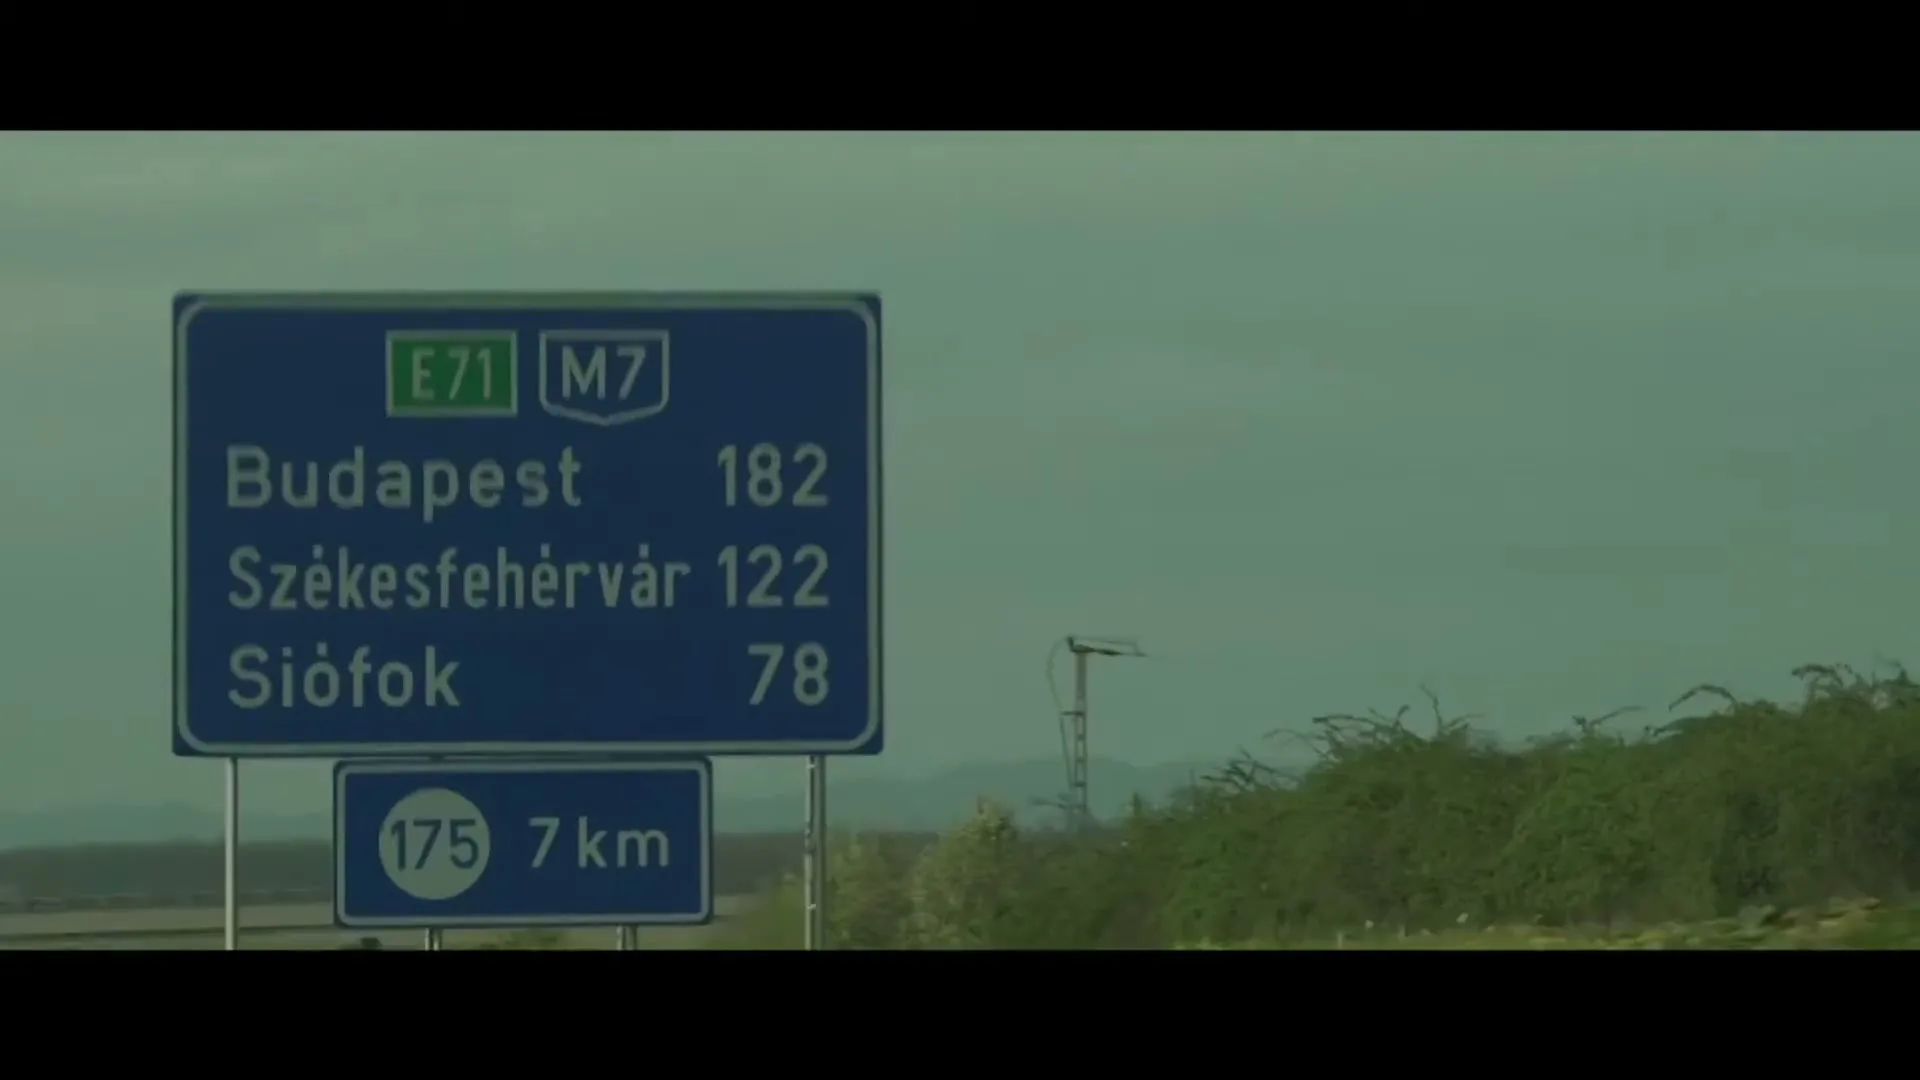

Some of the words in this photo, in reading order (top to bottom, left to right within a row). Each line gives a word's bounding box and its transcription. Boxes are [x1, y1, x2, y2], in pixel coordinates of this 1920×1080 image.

[561, 345, 647, 401] M7
[227, 445, 582, 522] Budapest
[717, 443, 830, 506] 182
[228, 543, 692, 611] Székesfehérvár
[717, 545, 830, 608] 122
[228, 641, 461, 709] Siófok
[746, 644, 830, 707] 78
[390, 818, 480, 870] 175
[528, 816, 561, 868] 7
[577, 815, 670, 868] km
